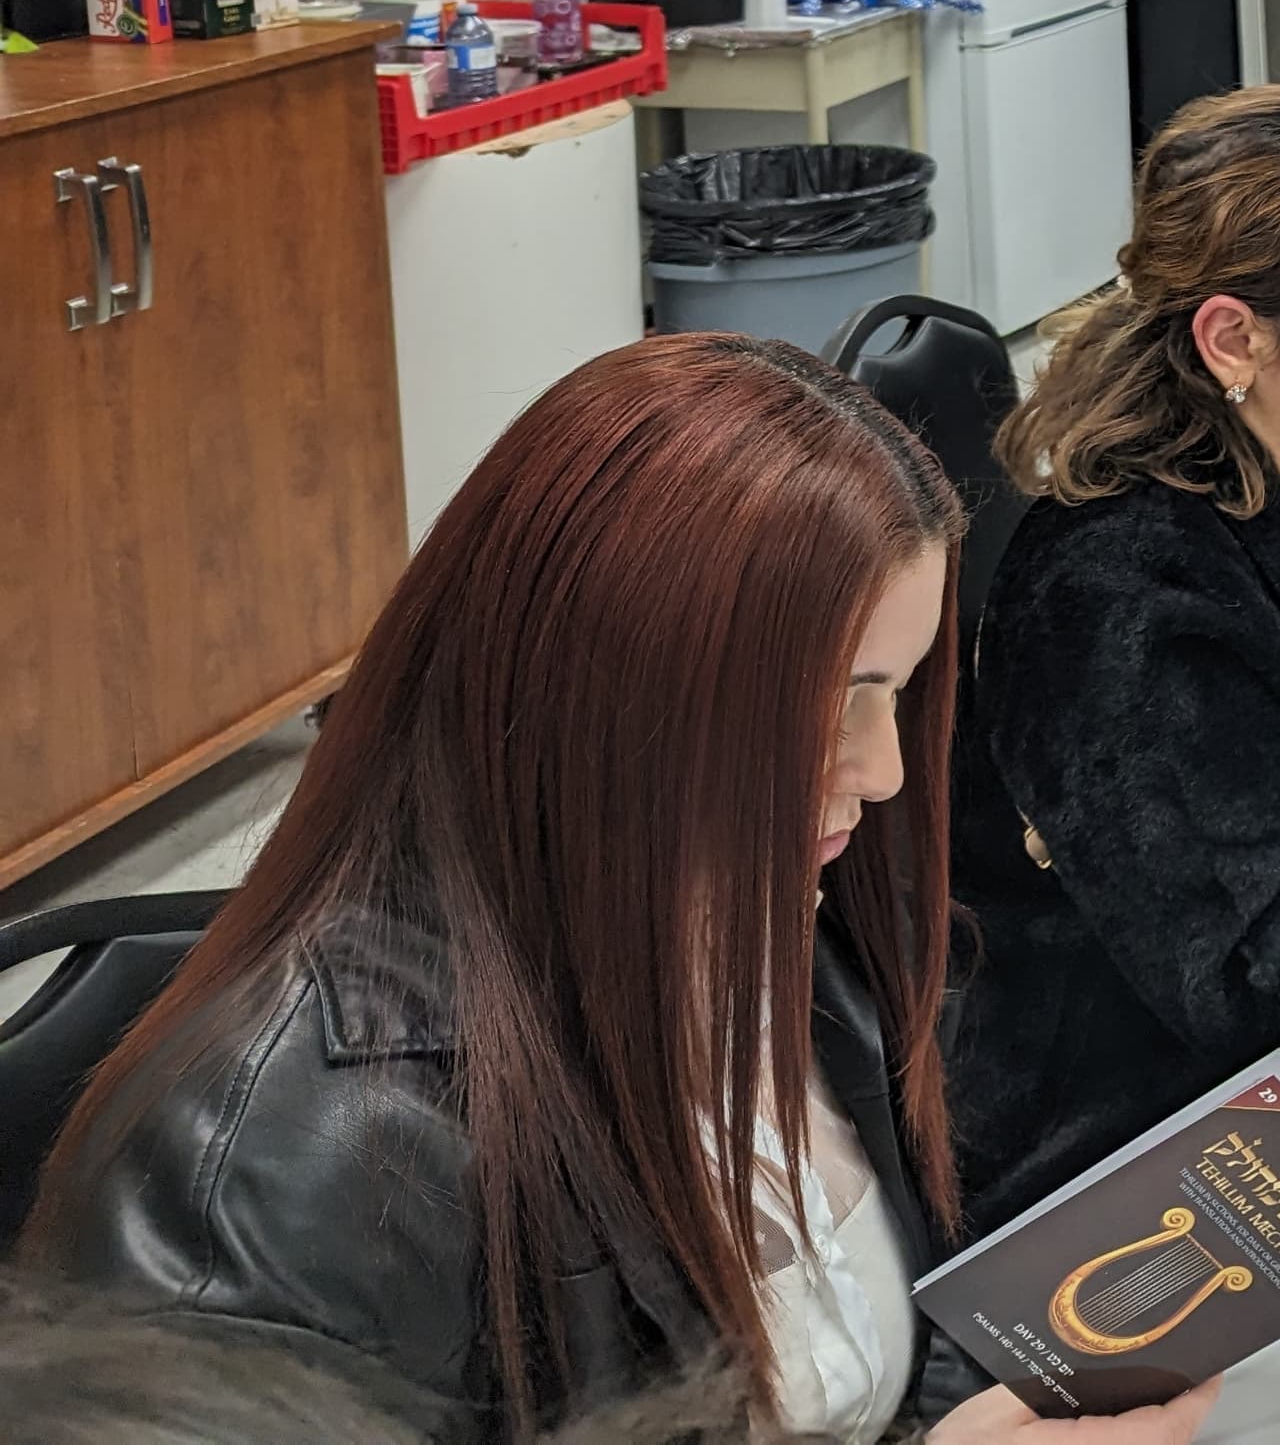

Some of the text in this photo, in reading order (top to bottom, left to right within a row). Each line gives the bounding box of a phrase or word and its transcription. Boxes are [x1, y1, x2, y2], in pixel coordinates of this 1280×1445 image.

[1258, 1087, 1278, 1104] 29
[1195, 1156, 1252, 1215] TEHILLIM
[1176, 1180, 1197, 1199] WITH
[1191, 1194, 1233, 1236] TRANSLATION
[1227, 1230, 1245, 1246] AND
[1234, 1224, 1250, 1238] FOR
[1245, 1234, 1265, 1253] DAILY
[973, 1312, 1001, 1337] PSALMS
[998, 1335, 1027, 1359] 140-144
[1013, 1323, 1036, 1341] DAY
[1030, 1339, 1046, 1352] 29
